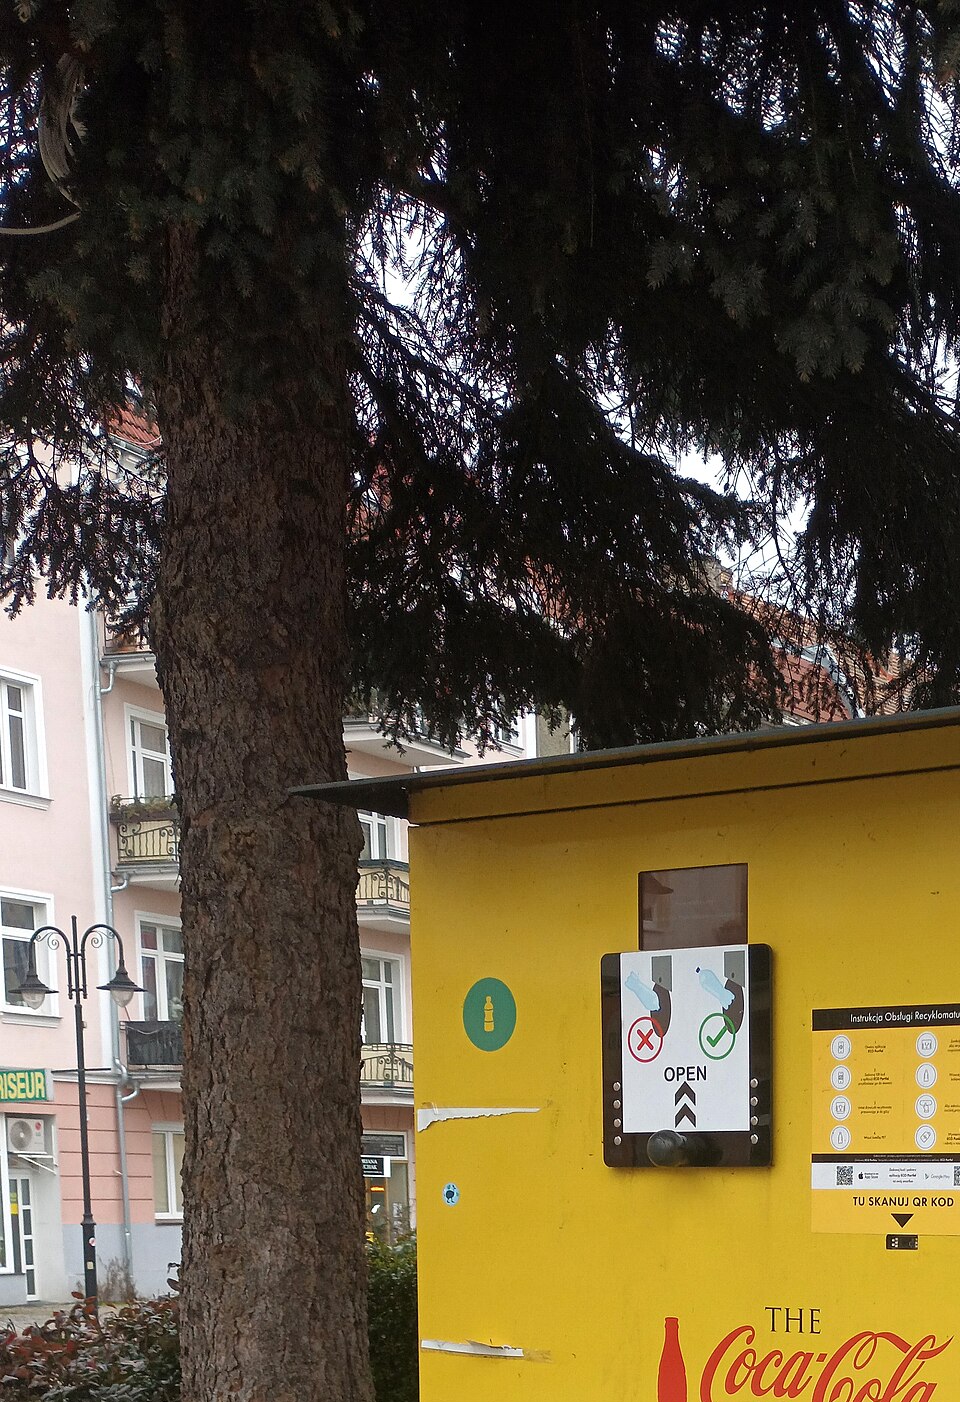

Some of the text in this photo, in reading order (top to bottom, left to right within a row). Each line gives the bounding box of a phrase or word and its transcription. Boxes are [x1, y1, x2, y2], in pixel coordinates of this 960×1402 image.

[850, 1010, 960, 1024] Instrukcja Obsługi Recyklomatu
[664, 1065, 707, 1082] OPEN
[853, 1196, 954, 1207] TU SKANUJ QR KOD
[765, 1306, 821, 1334] THE
